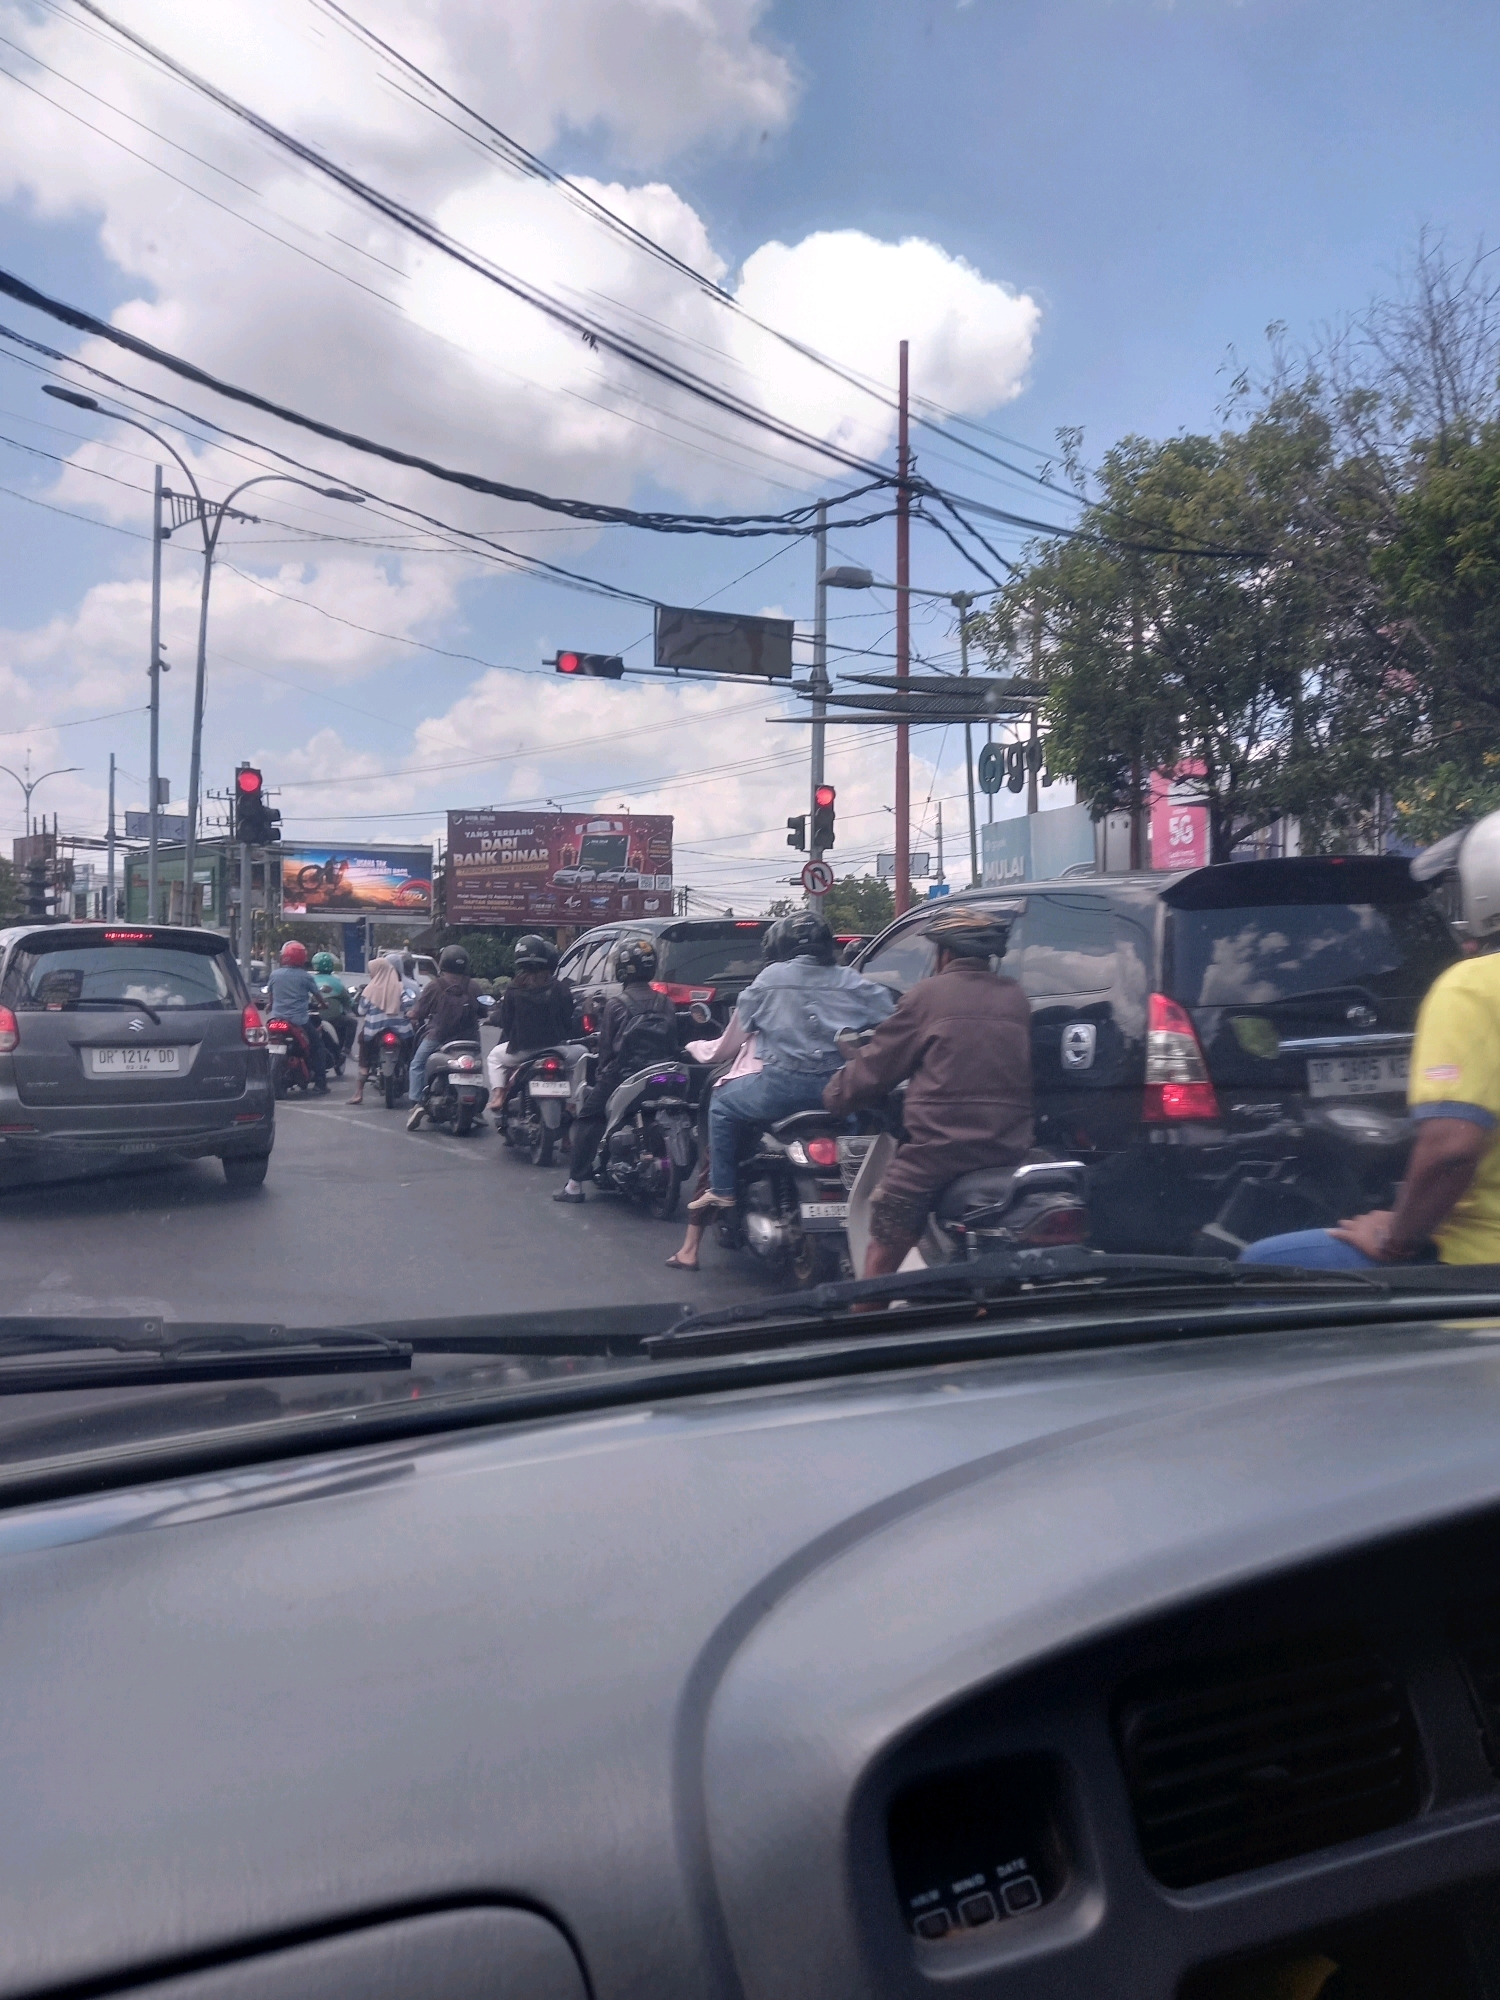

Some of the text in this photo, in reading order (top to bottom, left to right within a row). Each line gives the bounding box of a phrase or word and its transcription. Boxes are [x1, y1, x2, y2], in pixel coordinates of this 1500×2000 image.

[464, 828, 534, 838] YANG TERBARU
[1169, 814, 1194, 846] 5G
[481, 837, 518, 851] DARI
[453, 848, 549, 867] BANK DINAR
[984, 856, 1024, 881] MULAI
[121, 1049, 151, 1064] 1214
[158, 1049, 175, 1063] DD
